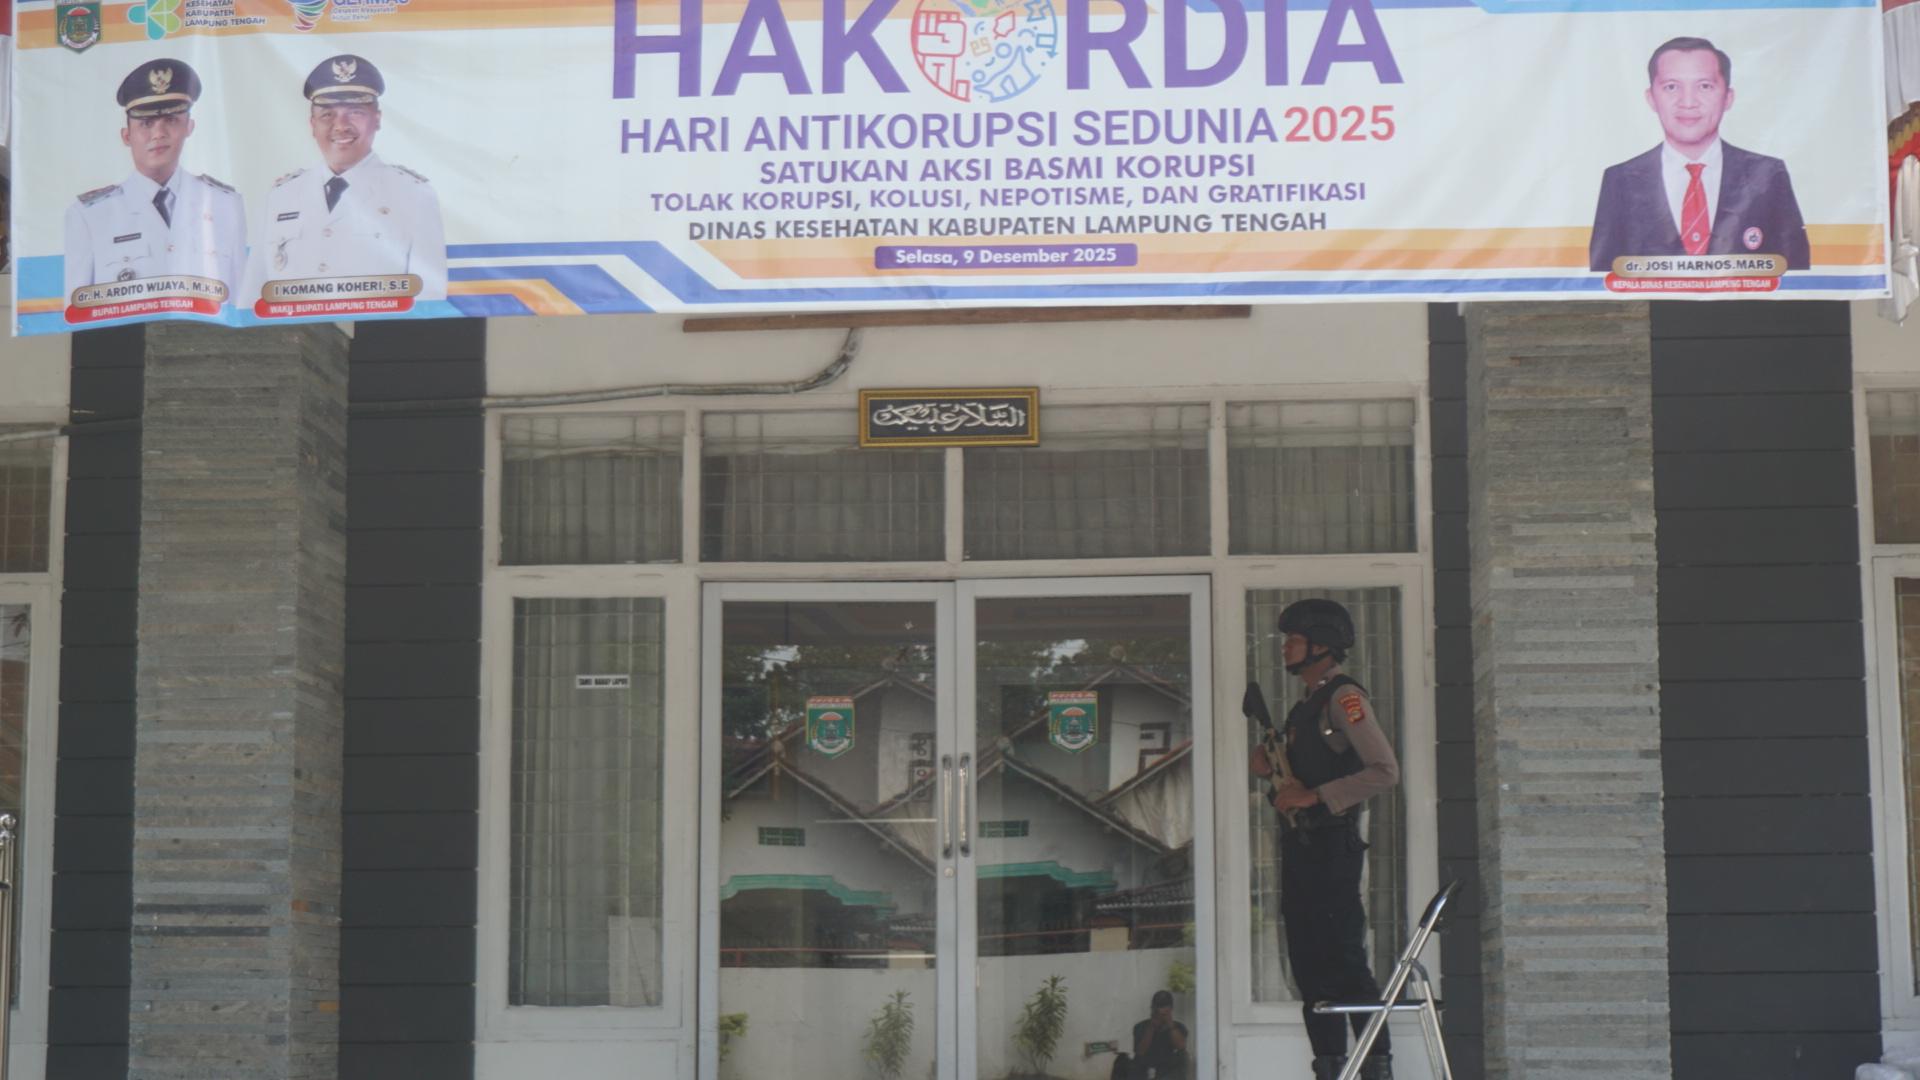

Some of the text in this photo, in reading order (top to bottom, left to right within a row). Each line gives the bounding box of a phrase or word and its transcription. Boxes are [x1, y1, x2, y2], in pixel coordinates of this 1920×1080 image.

[185, 9, 235, 17] KABUPATEN
[185, 17, 265, 27] LAMPUNG TENGAH
[621, 105, 1395, 154] HARI ANTIKORUPSI SEDUNIA 2025
[760, 154, 1255, 184] SATUKAN AKSI BASMI KORUPSI
[651, 182, 1365, 211] TOLAK KORUPSI, KOLUSI, NEPOTISME, DAN GRATIFIKASI
[690, 212, 1326, 241] DINAS KESEHATAN KABUPATEN LAMPUNG TENGAH
[896, 248, 1117, 266] Selasa, 9 Desember 2025
[1626, 261, 1642, 271] dr.
[1646, 260, 1673, 271] JOSI
[78, 281, 223, 301] dr. H. ARDITO WIJAYA, M.K.M
[282, 284, 333, 295] KOMANG
[337, 282, 386, 292] KOHERI,
[389, 280, 409, 290] S.E
[1613, 279, 1771, 289] KEPALA DINAS KESEHATAN LAMPUNG TENGAH
[92, 300, 193, 317] BUPATI LAMPUNG TENGAH
[270, 300, 398, 315] WAKIL BUPATI LAMPUNG TENGAH
